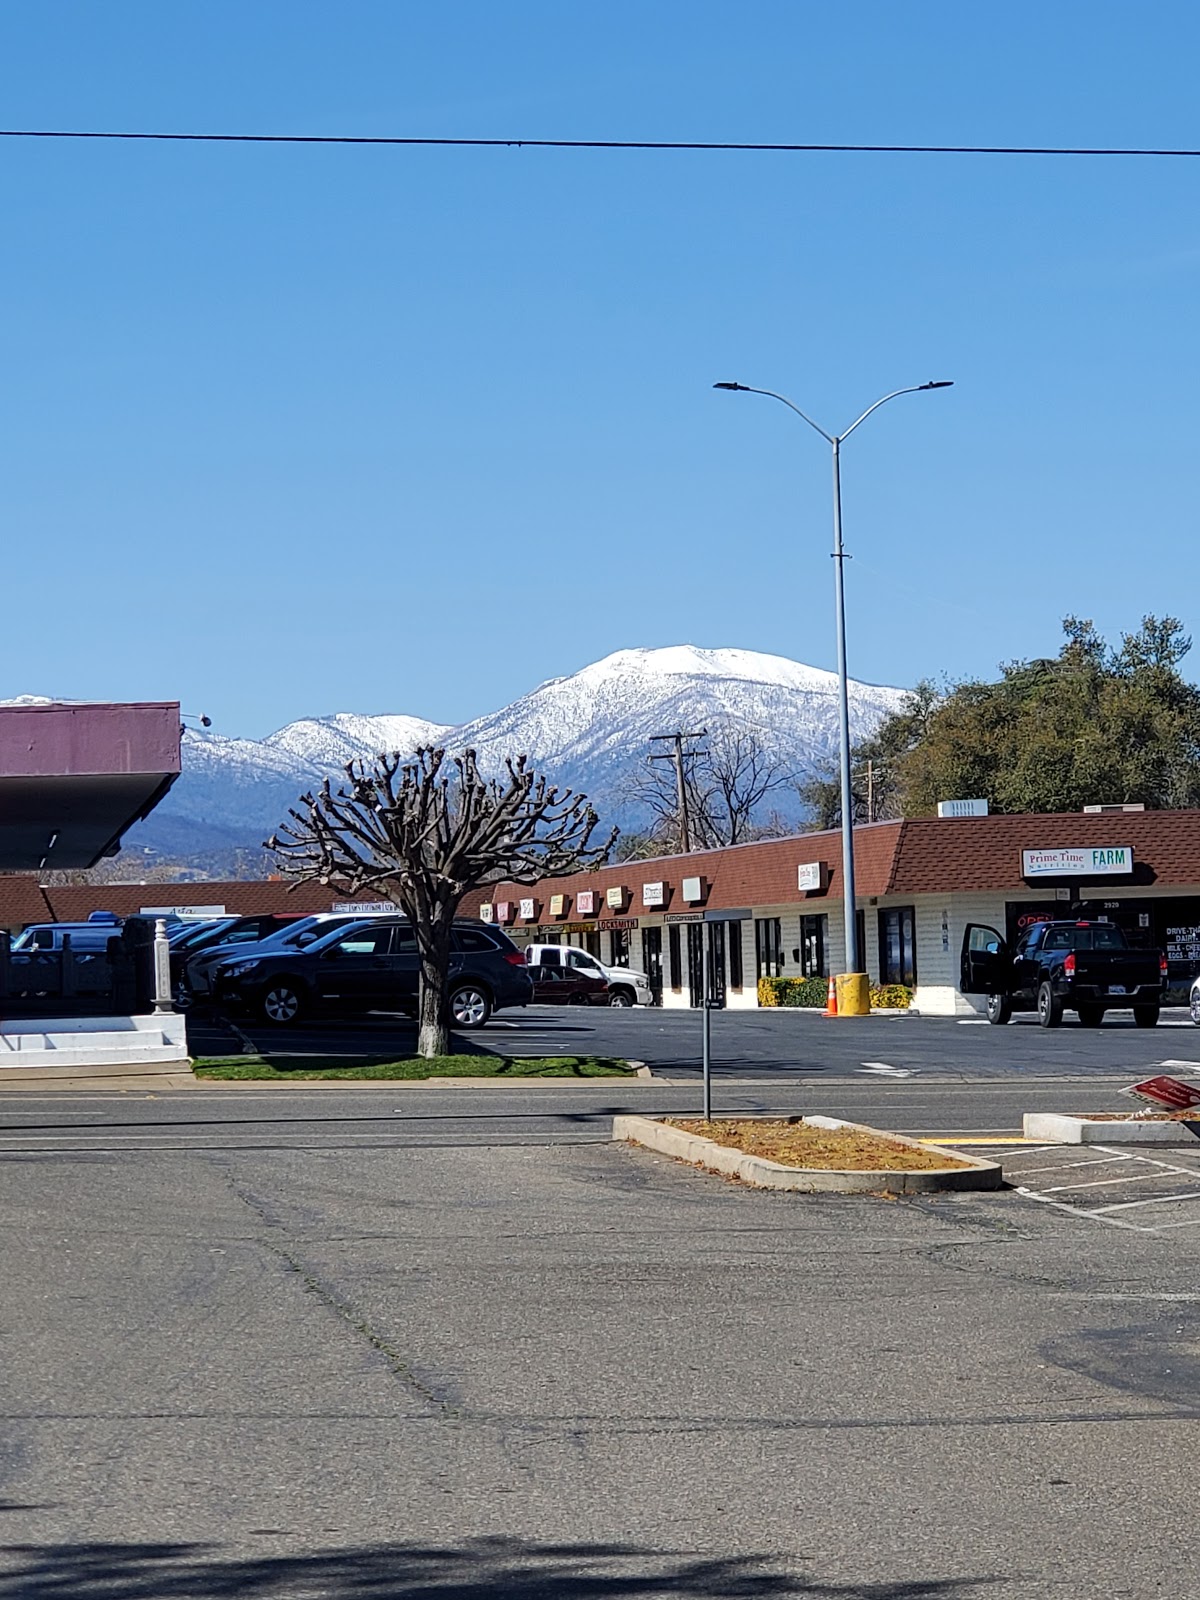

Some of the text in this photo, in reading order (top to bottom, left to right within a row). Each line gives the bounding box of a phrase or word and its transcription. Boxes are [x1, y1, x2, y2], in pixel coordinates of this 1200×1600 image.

[1029, 850, 1084, 864] Prime Time
[1092, 849, 1125, 865] FARM
[1029, 862, 1085, 870] Nutrition
[598, 920, 635, 930] LOCKSMITH
